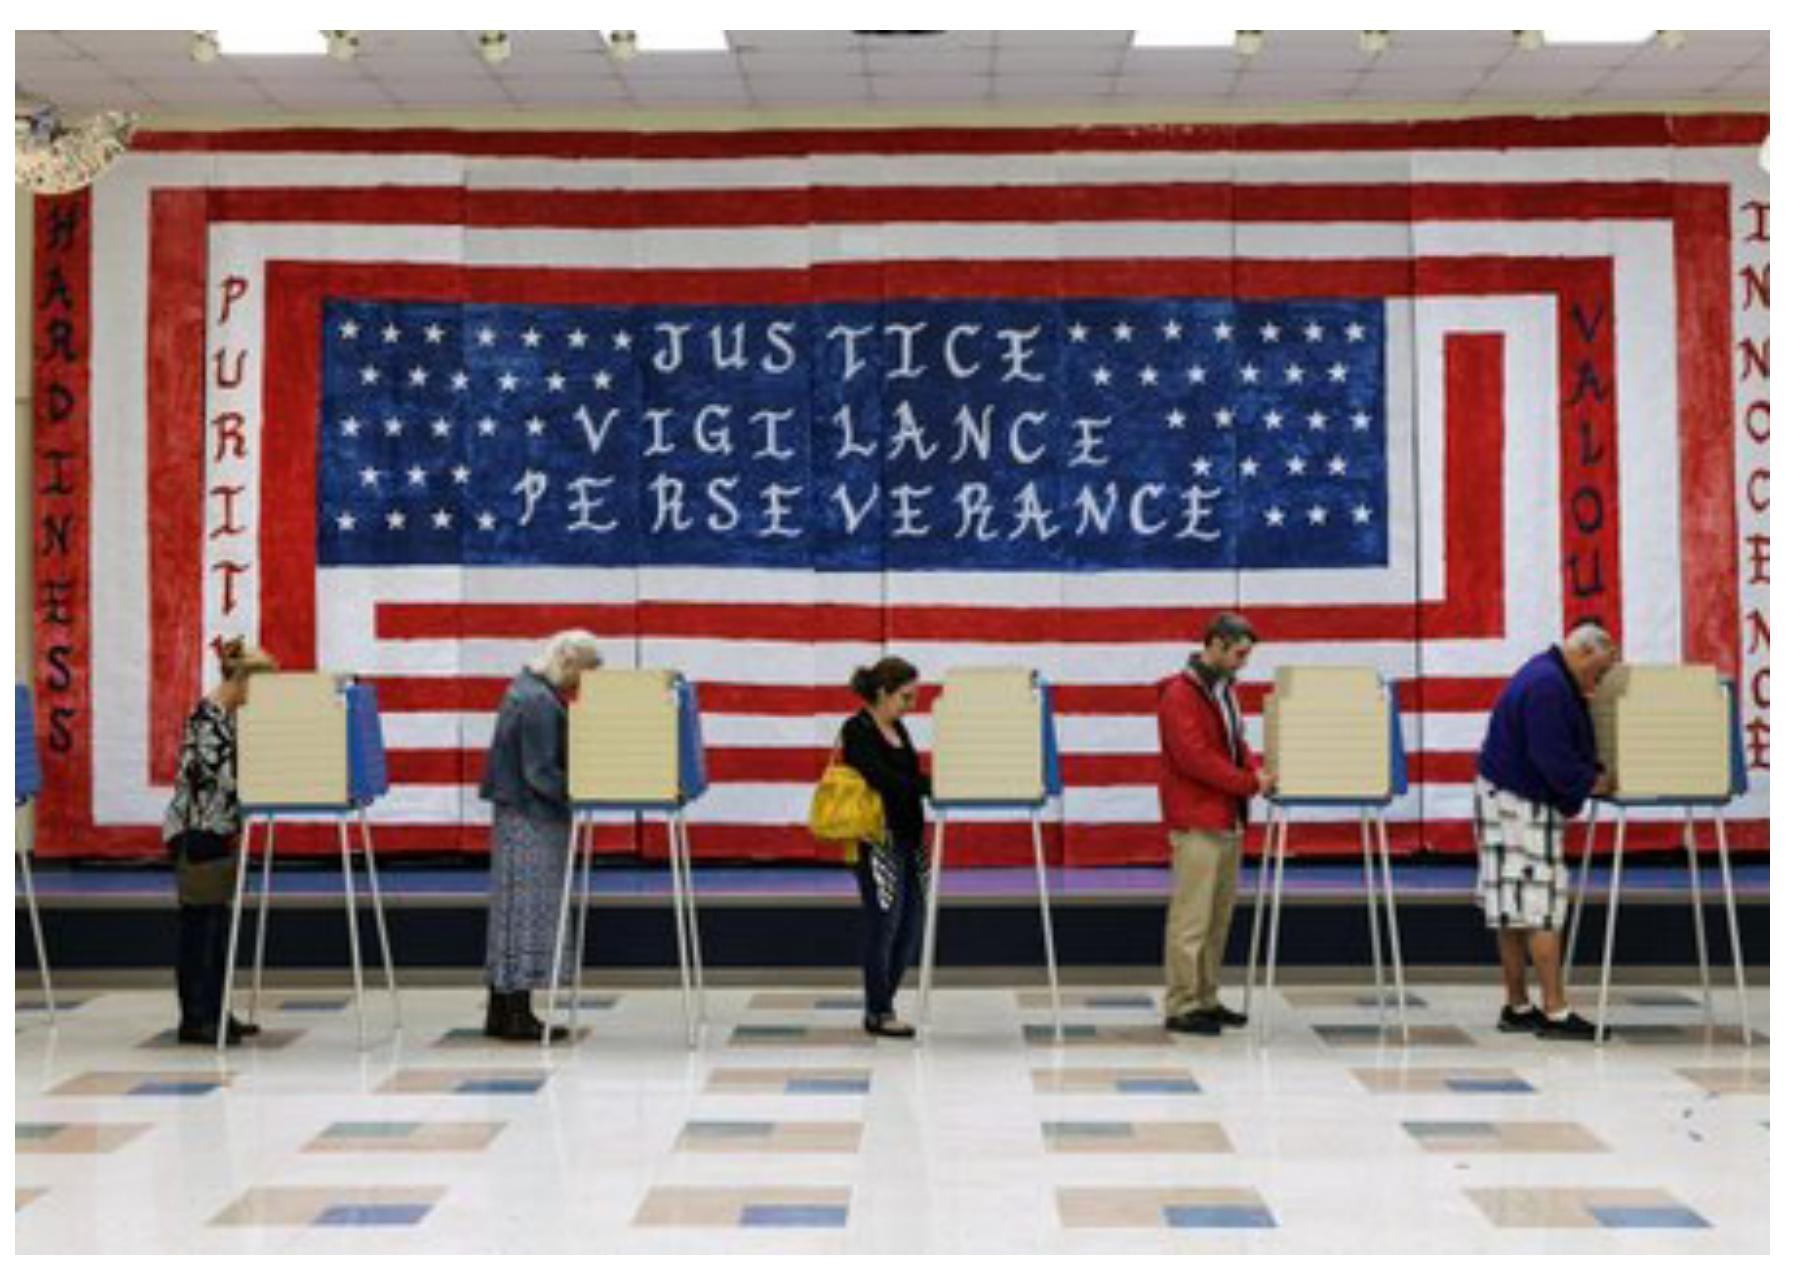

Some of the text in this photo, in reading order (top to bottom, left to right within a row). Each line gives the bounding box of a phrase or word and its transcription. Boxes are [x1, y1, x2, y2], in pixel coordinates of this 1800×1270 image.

[652, 321, 1046, 383] JUSTICE
[572, 400, 1113, 467] VIGILANCE
[1566, 300, 1610, 628] VALOU
[38, 196, 82, 754] HARDINESS
[511, 468, 1223, 542] PERSEVERANCE
